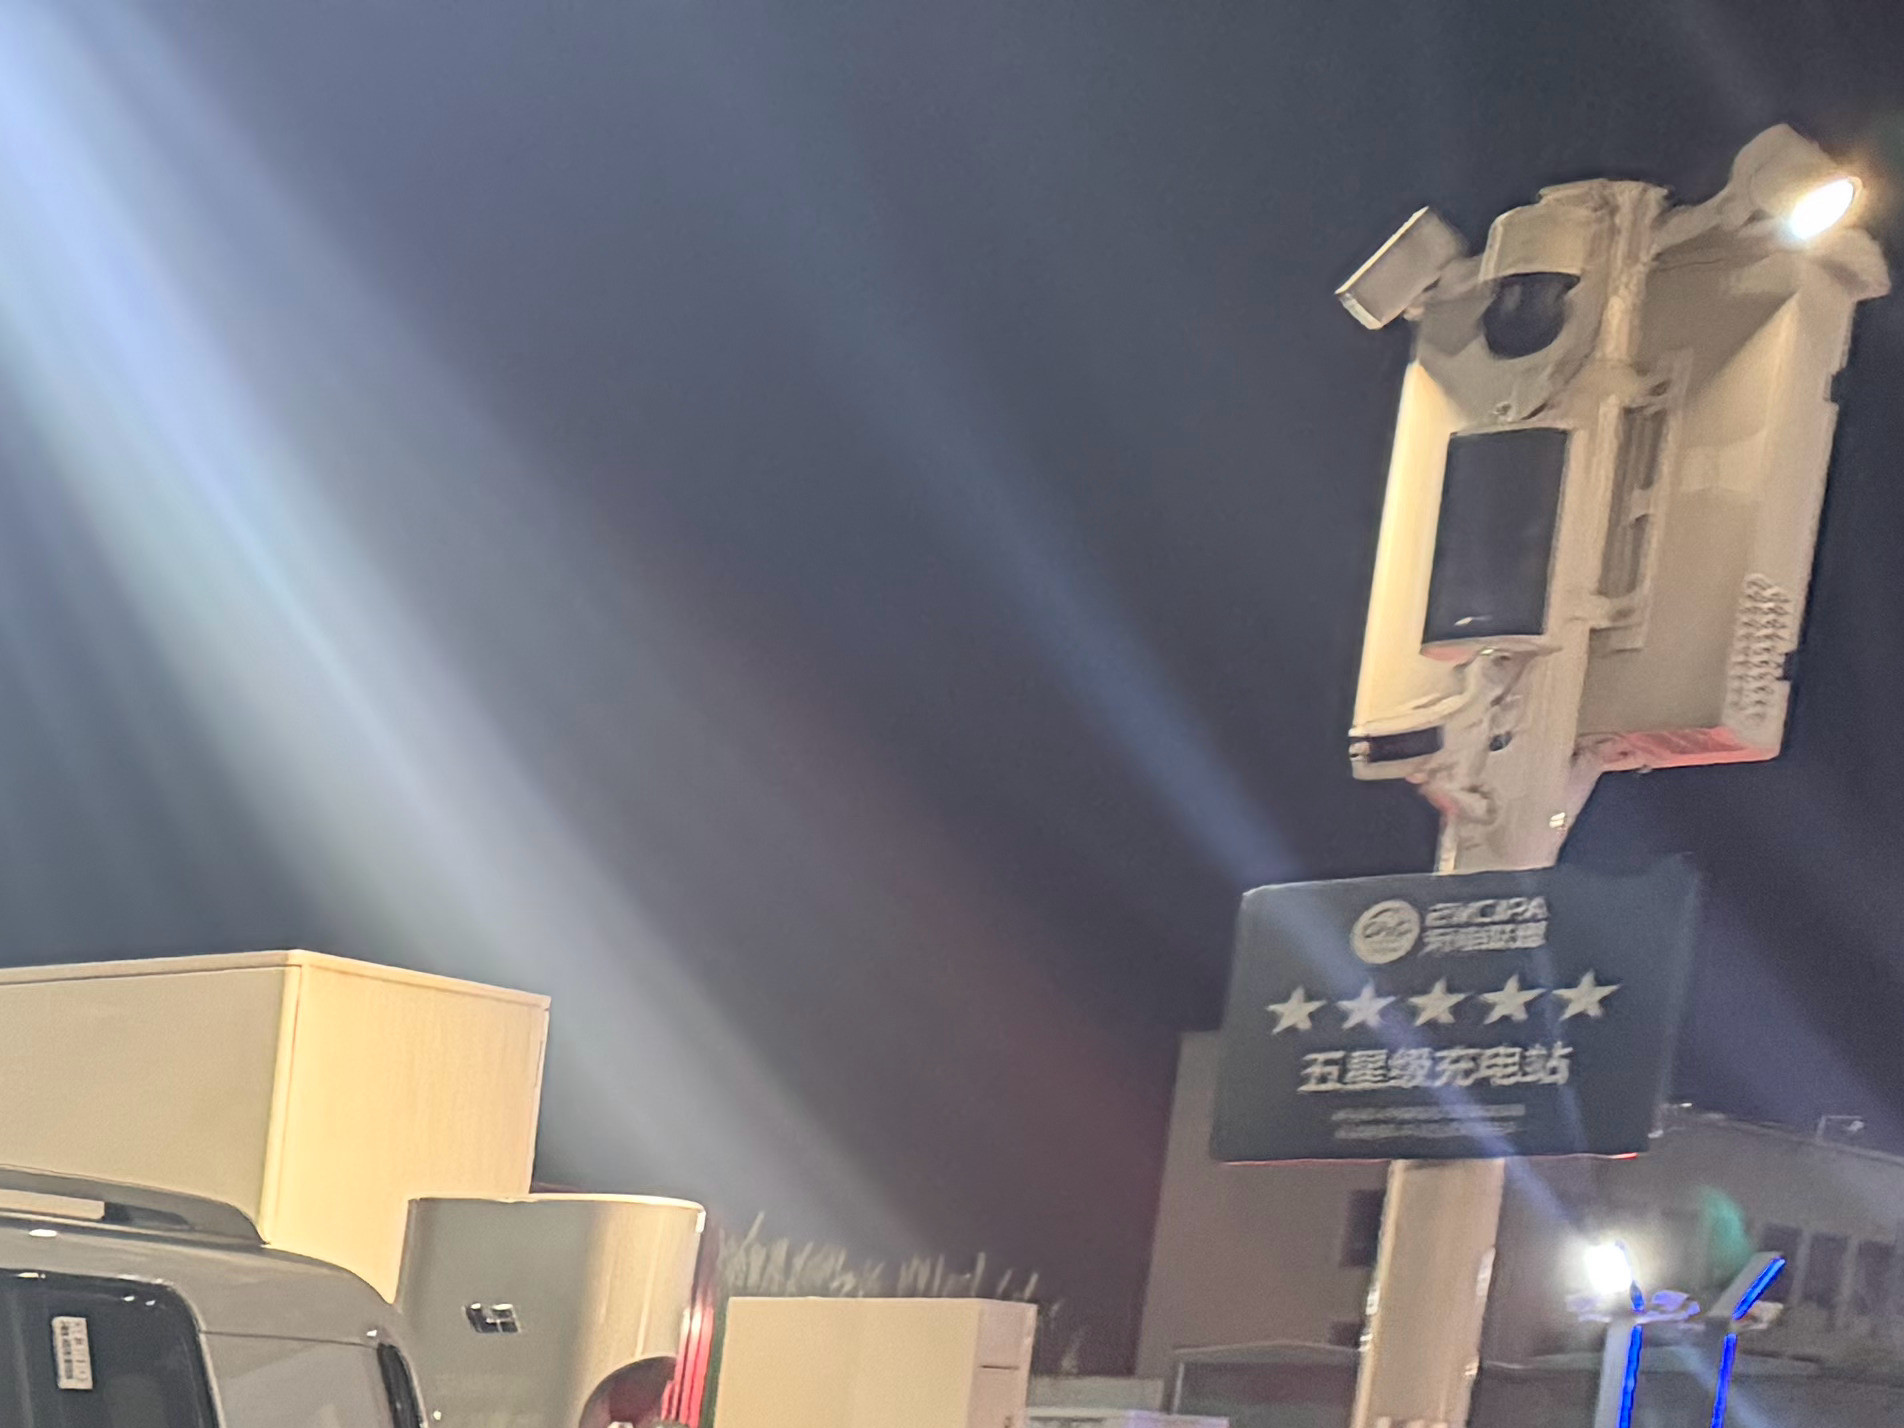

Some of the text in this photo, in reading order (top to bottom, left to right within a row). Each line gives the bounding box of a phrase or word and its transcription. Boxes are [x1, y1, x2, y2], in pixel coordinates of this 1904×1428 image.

[1297, 1041, 1573, 1093] 五星级充电站
